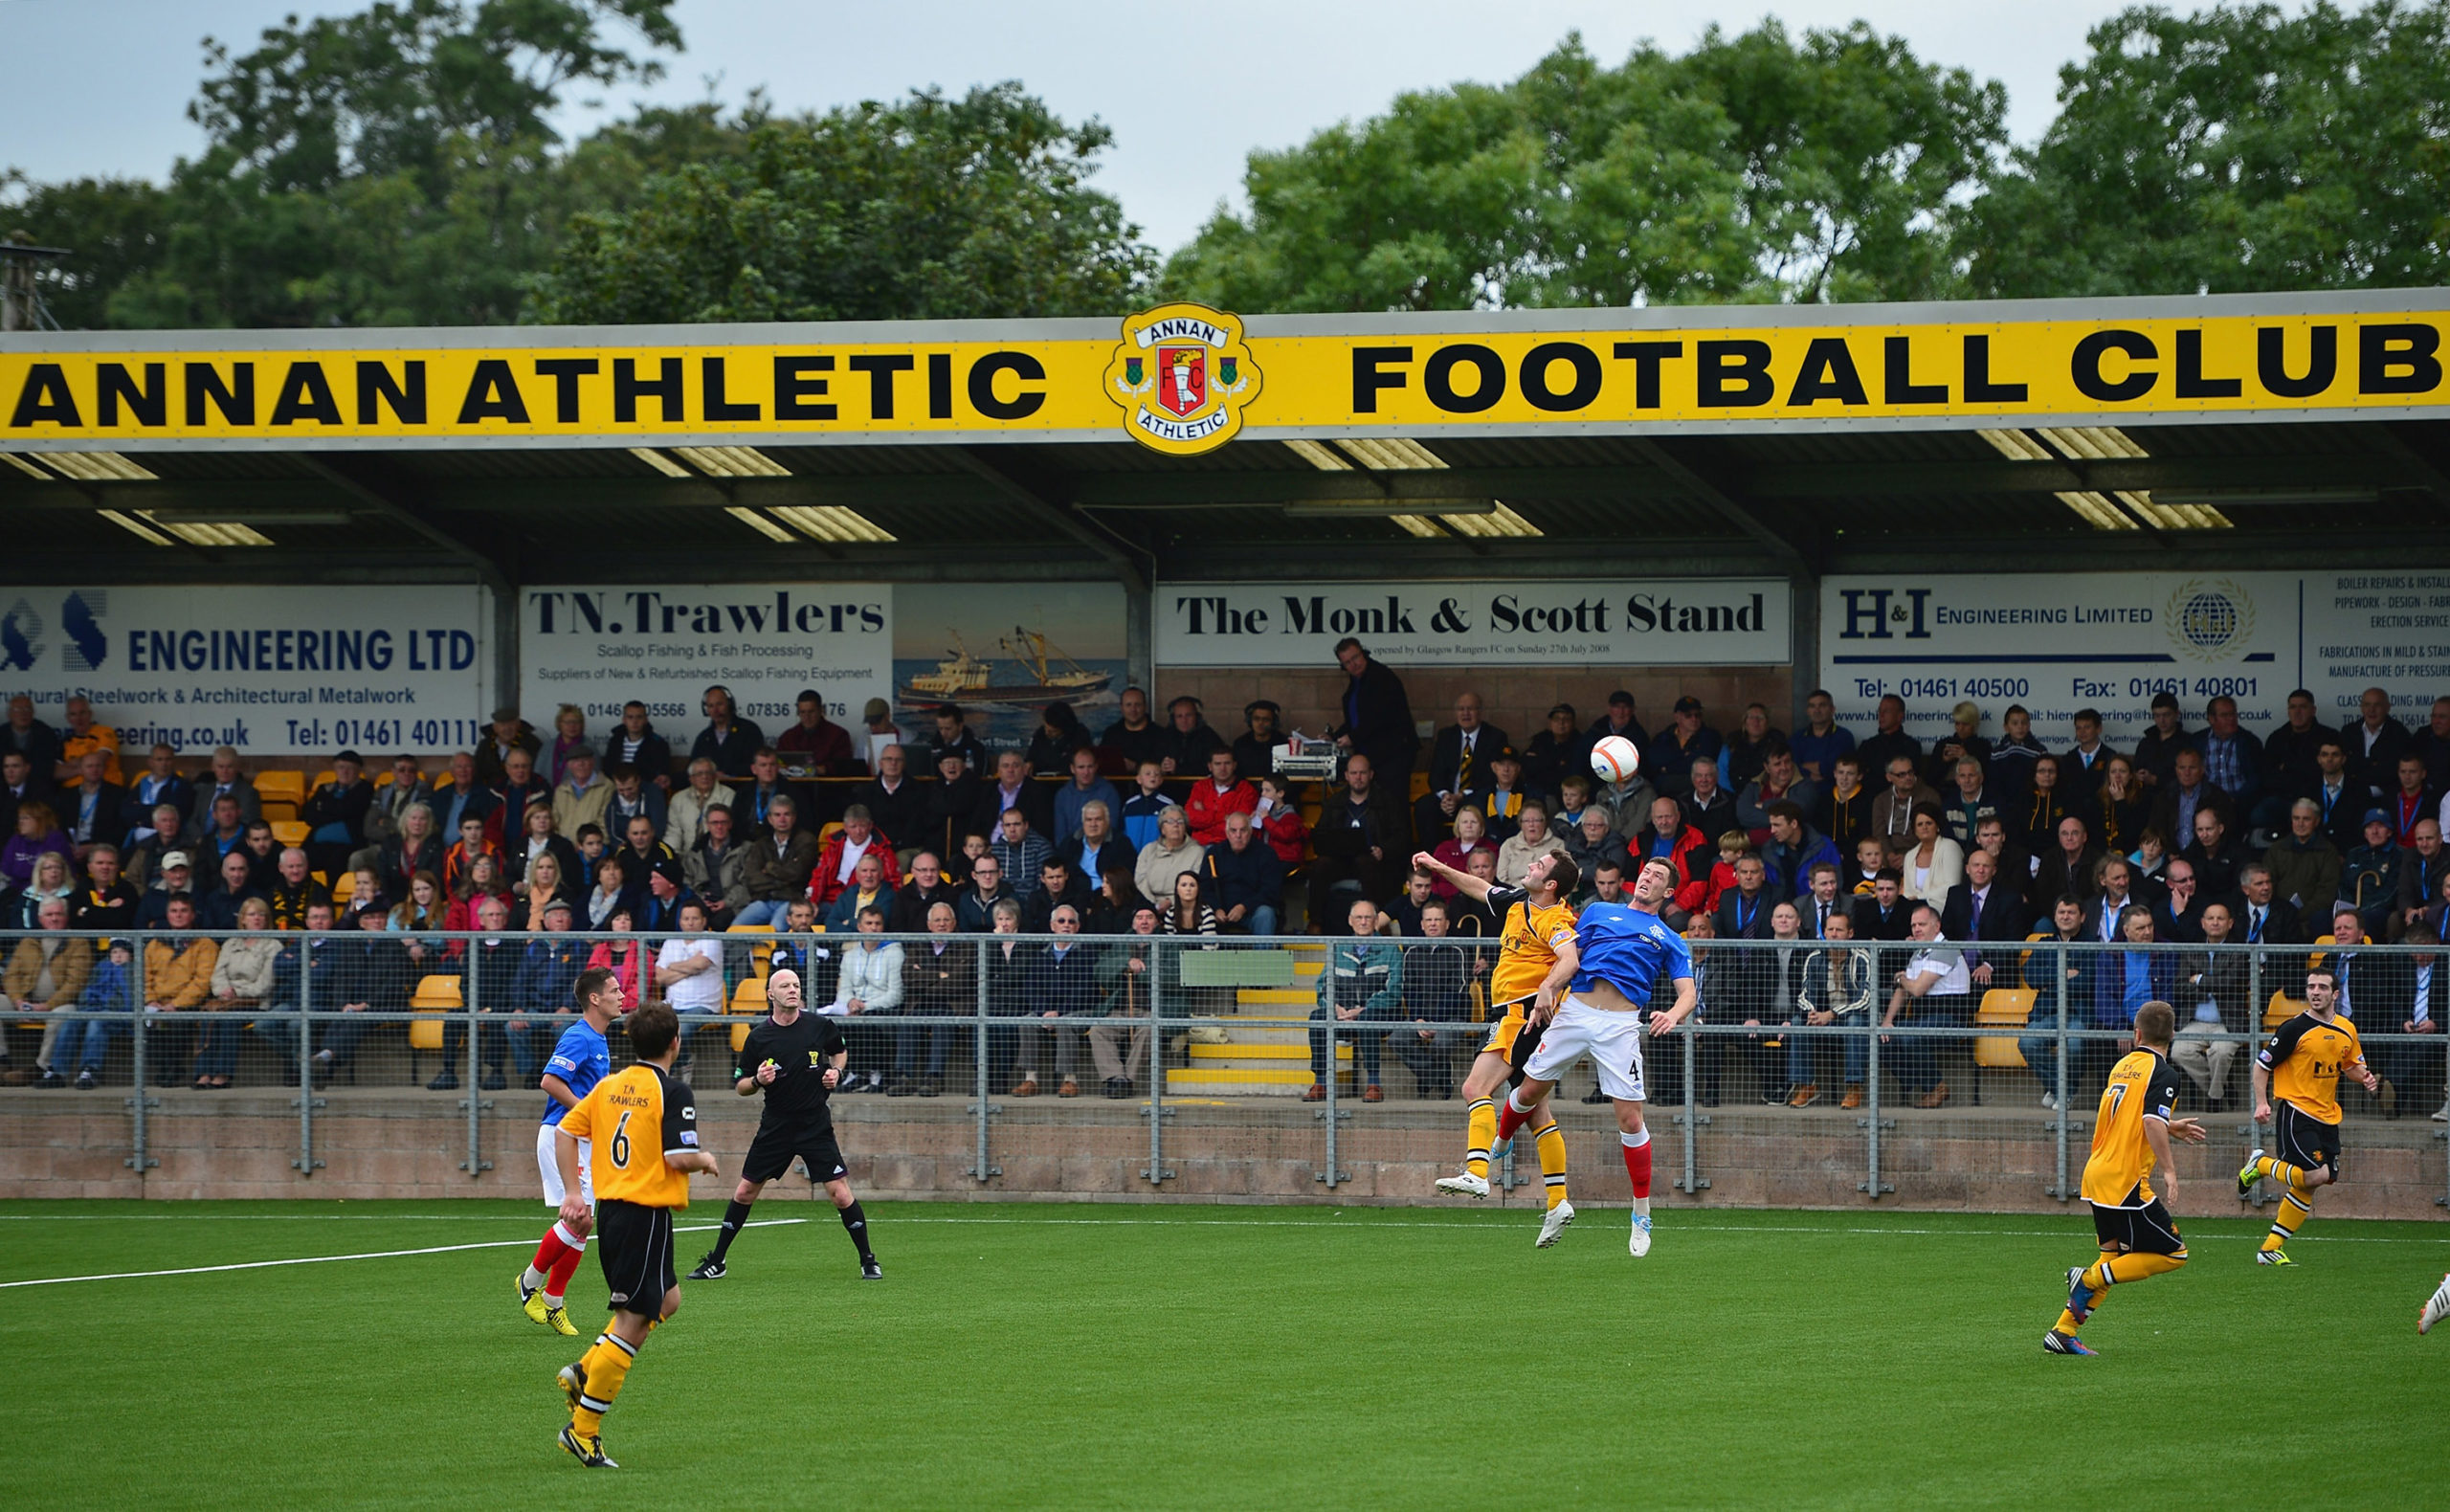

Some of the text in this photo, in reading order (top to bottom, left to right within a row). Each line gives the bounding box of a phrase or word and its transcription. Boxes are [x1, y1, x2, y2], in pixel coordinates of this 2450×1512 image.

[1150, 320, 1215, 343] ANNAN
[1351, 322, 2443, 413] FOOTBALL CLUB
[10, 350, 1047, 428] ANNAN ATHLETIC
[1140, 412, 1225, 439] ATHLETIC
[2337, 576, 2369, 590] BOILER
[2371, 576, 2406, 590] REPAIRS
[528, 589, 885, 634] TN.Trawlers
[1176, 592, 1766, 634] The Monk & Scott Stand
[2335, 596, 2380, 609] PIPEWORK
[2389, 595, 2420, 609] DESIGN
[1936, 604, 2153, 631] ENGINEERING LIMITED
[2371, 614, 2412, 628] ERECTION
[128, 629, 476, 672] ENGINEERING LTD
[596, 643, 813, 660] Scallop Fishing & Fish Processing
[1373, 644, 1403, 656] opened
[1405, 643, 1414, 656] by
[1417, 643, 1453, 656] Glasgow
[1455, 642, 1488, 656] Rangers
[1490, 642, 1503, 654] FC
[1504, 645, 1516, 654] on
[1518, 642, 1548, 656] Sunday
[1550, 642, 1569, 654] 27th
[1570, 642, 1587, 656] July
[1590, 642, 1611, 654] 2008
[2320, 645, 2380, 658] FABRICATIONS
[2383, 645, 2392, 658] IN
[2394, 645, 2417, 658] MILD
[2418, 645, 2425, 658] &
[538, 666, 873, 682] Suppliers of New & Refurbished Scallop Fishing Equipment
[2329, 664, 2392, 678] MANUFACTURE
[2394, 664, 2406, 678] OF
[76, 686, 167, 705] Steelwork
[174, 687, 186, 704] &
[190, 686, 312, 705] Architectural
[319, 686, 416, 704] Metalwork
[1901, 678, 1957, 699] 01461
[1964, 678, 2029, 699] 40500
[2073, 677, 2258, 698] Fax: 01461 40801
[588, 702, 623, 718] 0146
[746, 702, 791, 717] 07836
[285, 718, 327, 745] Tel:
[335, 719, 401, 746] 01461
[411, 719, 478, 746] 40111
[1629, 1058, 1639, 1081] 4
[2107, 1082, 2129, 1120] 7
[611, 1110, 633, 1169] 6
